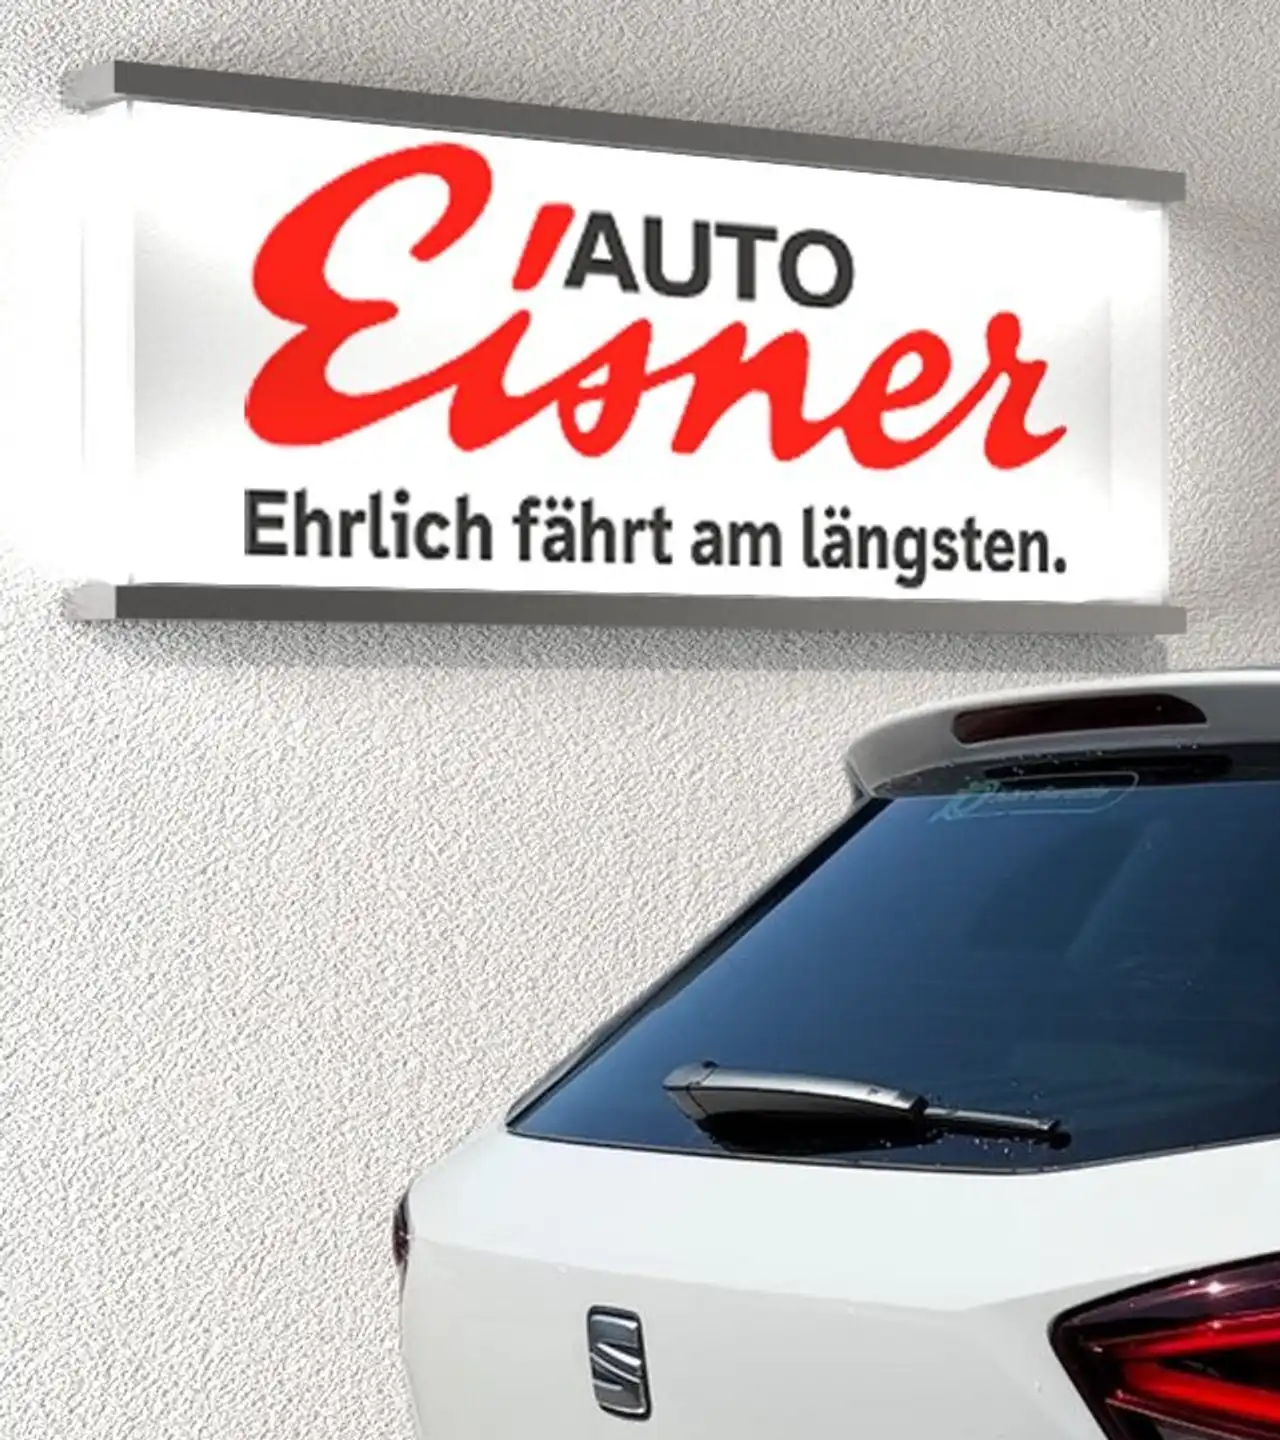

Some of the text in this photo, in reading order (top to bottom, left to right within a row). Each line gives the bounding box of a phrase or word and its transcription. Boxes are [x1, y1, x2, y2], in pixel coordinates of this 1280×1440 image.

[243, 141, 1068, 472] Eisner
[564, 211, 855, 309] AUTO
[244, 488, 1067, 589] Ehrlich fährt am längsten.
